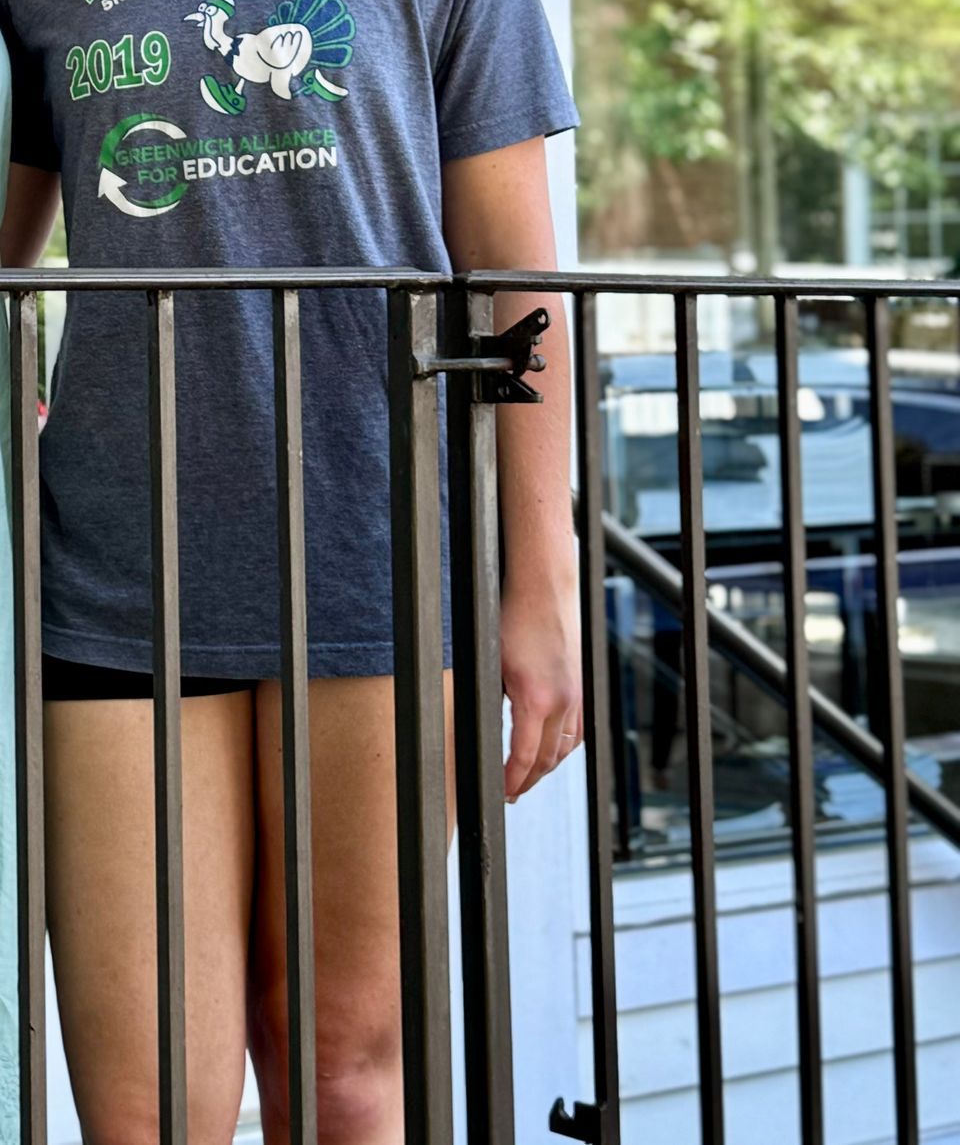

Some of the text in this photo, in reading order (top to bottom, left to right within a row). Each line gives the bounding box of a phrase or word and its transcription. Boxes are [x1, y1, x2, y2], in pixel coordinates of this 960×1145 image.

[66, 31, 171, 100] 2019
[115, 129, 336, 166] GREENWICH ALLIANCE
[137, 147, 338, 185] FOR EDUCATION
